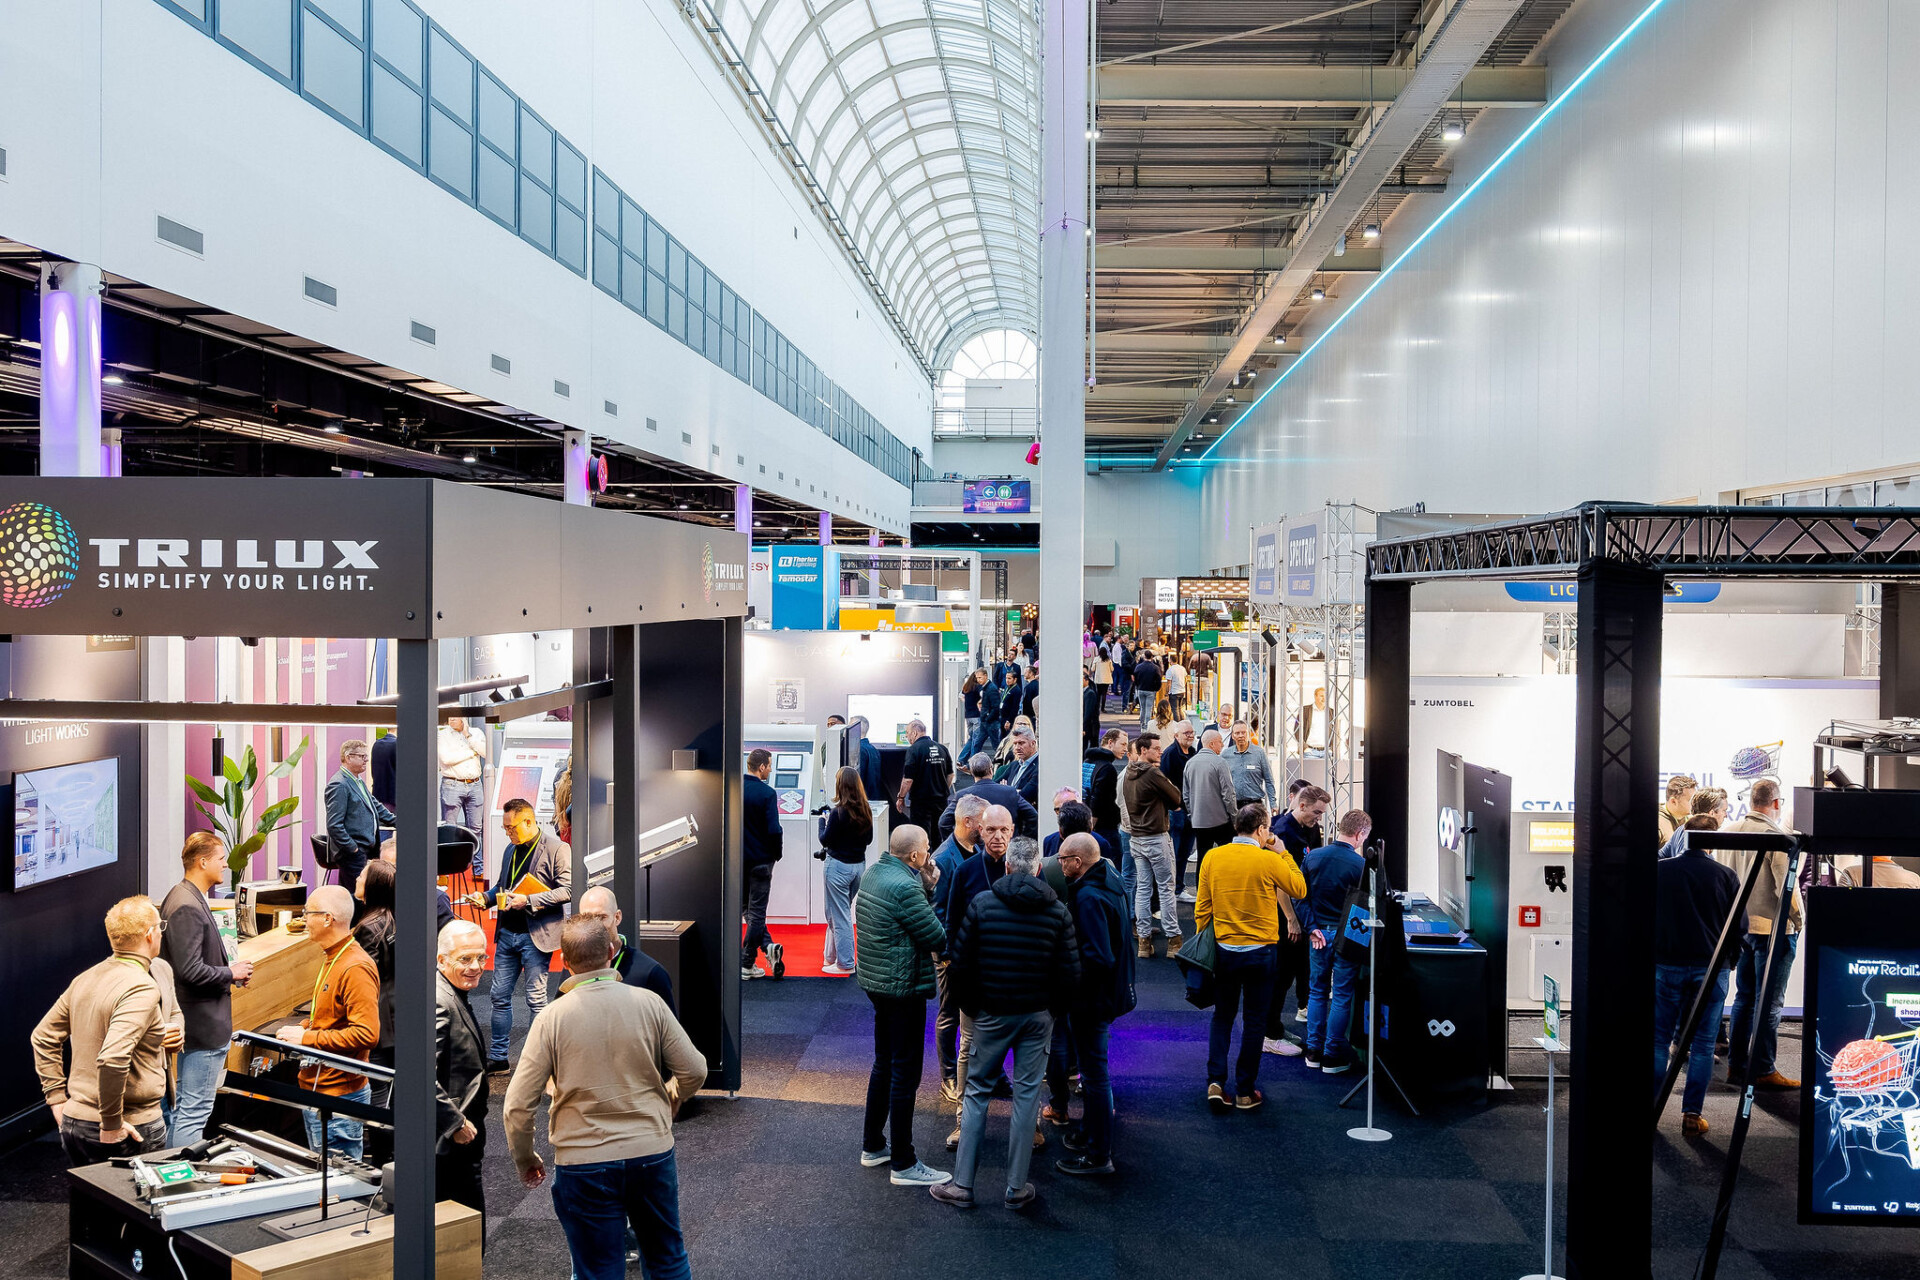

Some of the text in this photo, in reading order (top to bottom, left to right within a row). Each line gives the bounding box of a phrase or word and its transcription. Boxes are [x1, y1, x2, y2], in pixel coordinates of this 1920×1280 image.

[88, 538, 380, 569] TRILUX
[714, 563, 745, 580] TRILUX
[778, 574, 818, 583] Tamostar
[97, 573, 375, 591] SIMPLIFY YOUR LIGHT.
[1423, 699, 1475, 707] ZUMTOBEL
[25, 727, 54, 746] LIGHT
[55, 723, 90, 740] WORKS
[1848, 963, 1880, 975] New
[1843, 1204, 1877, 1212] ZUMTOBEL
